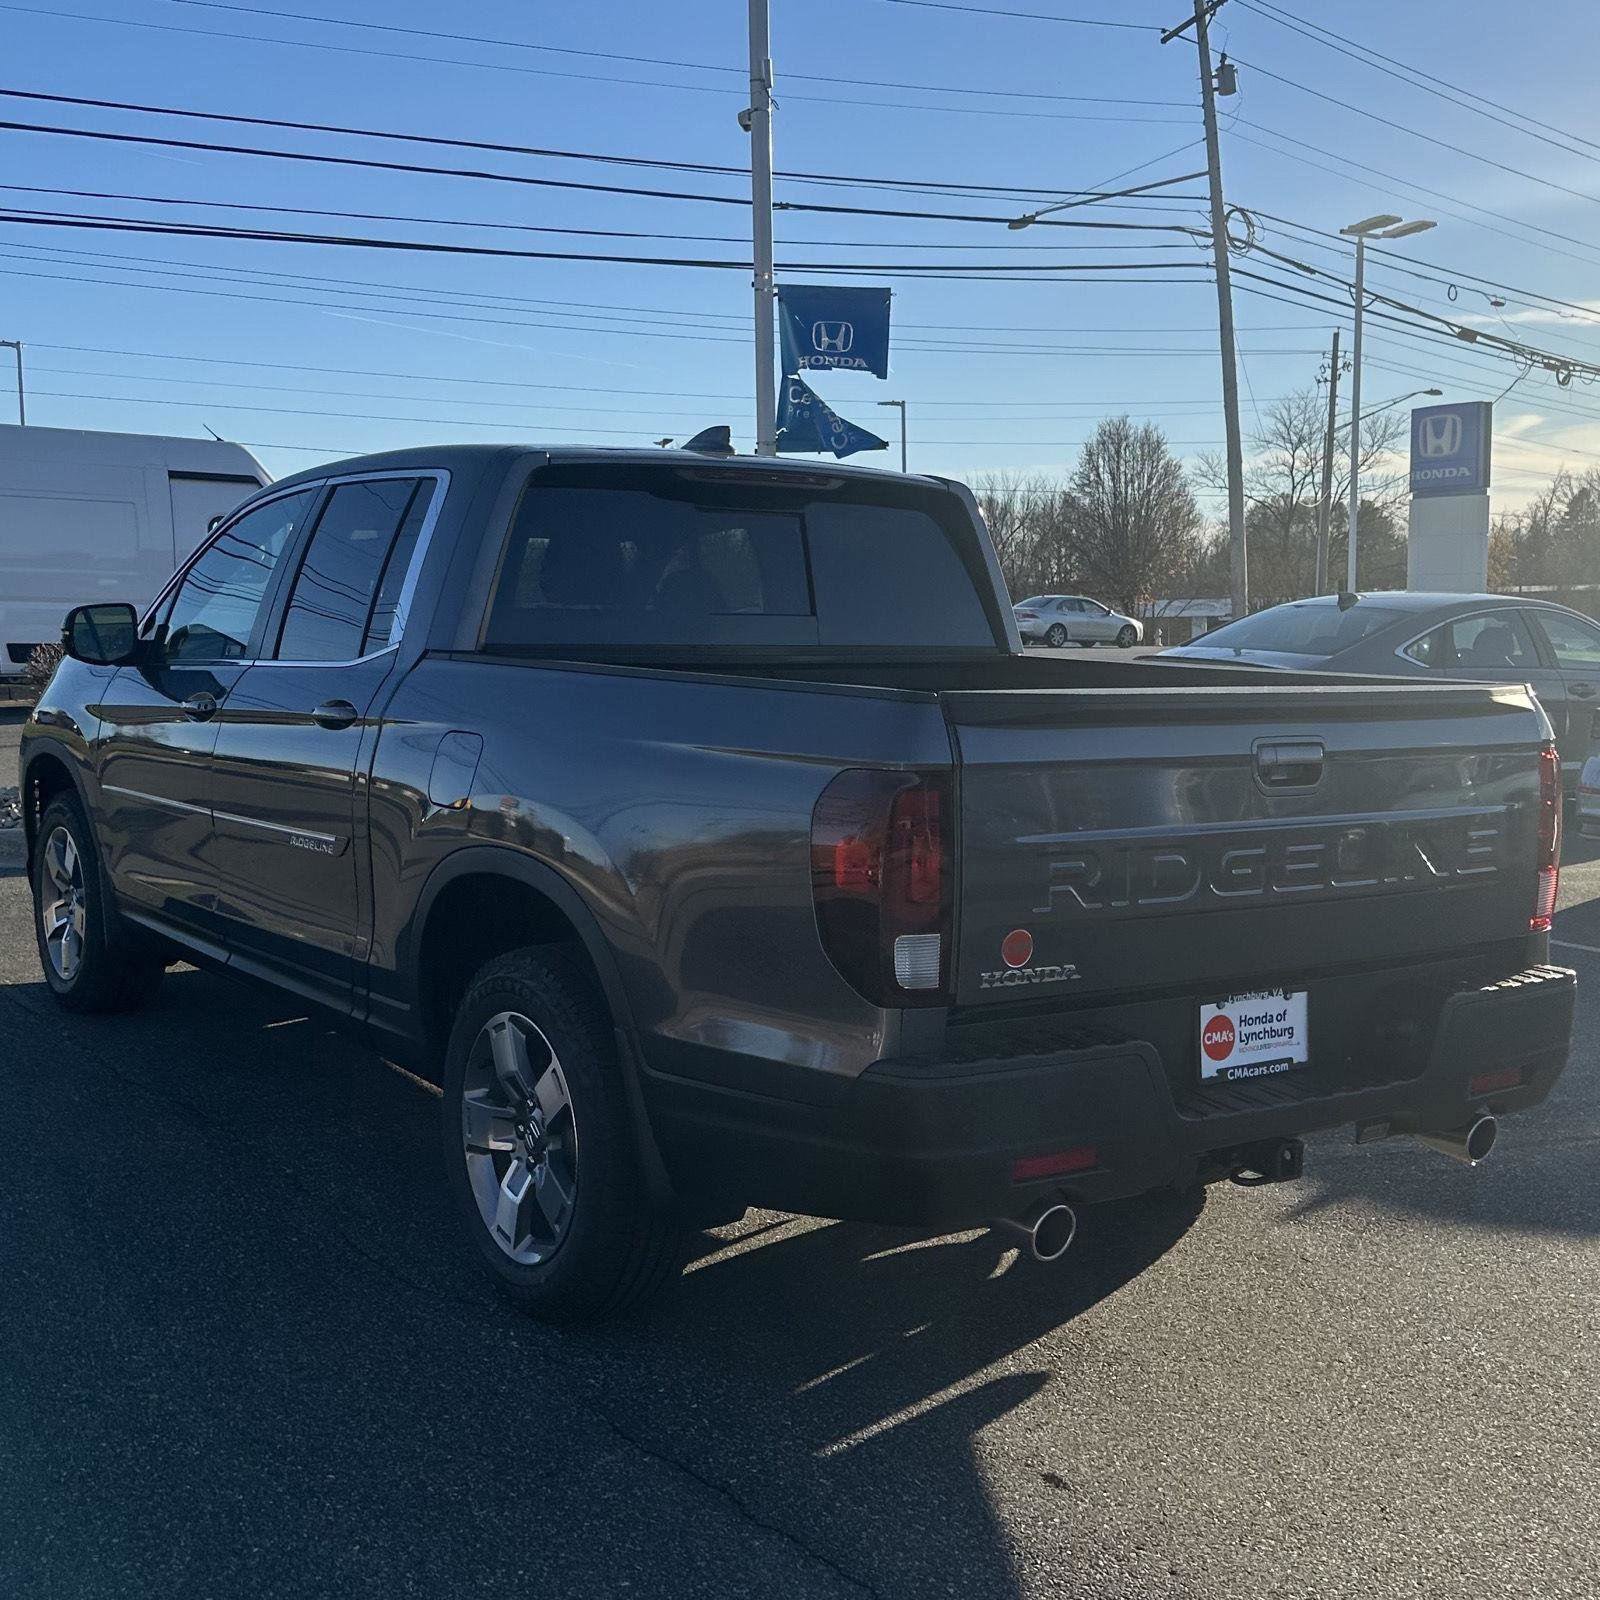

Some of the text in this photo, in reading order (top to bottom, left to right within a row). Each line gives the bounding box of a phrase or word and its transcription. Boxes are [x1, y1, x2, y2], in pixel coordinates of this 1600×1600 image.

[799, 355, 868, 369] HONDA
[1412, 467, 1472, 480] HONDA
[1033, 829, 1500, 914] RIDGELNE
[980, 963, 1082, 989] HONDA
[1272, 988, 1284, 998] VA
[1239, 1009, 1288, 1027] Honda of
[1204, 1030, 1234, 1045] CMA's
[1239, 1026, 1294, 1045] Lynchburg
[1227, 1062, 1289, 1080] CMAcars.com
